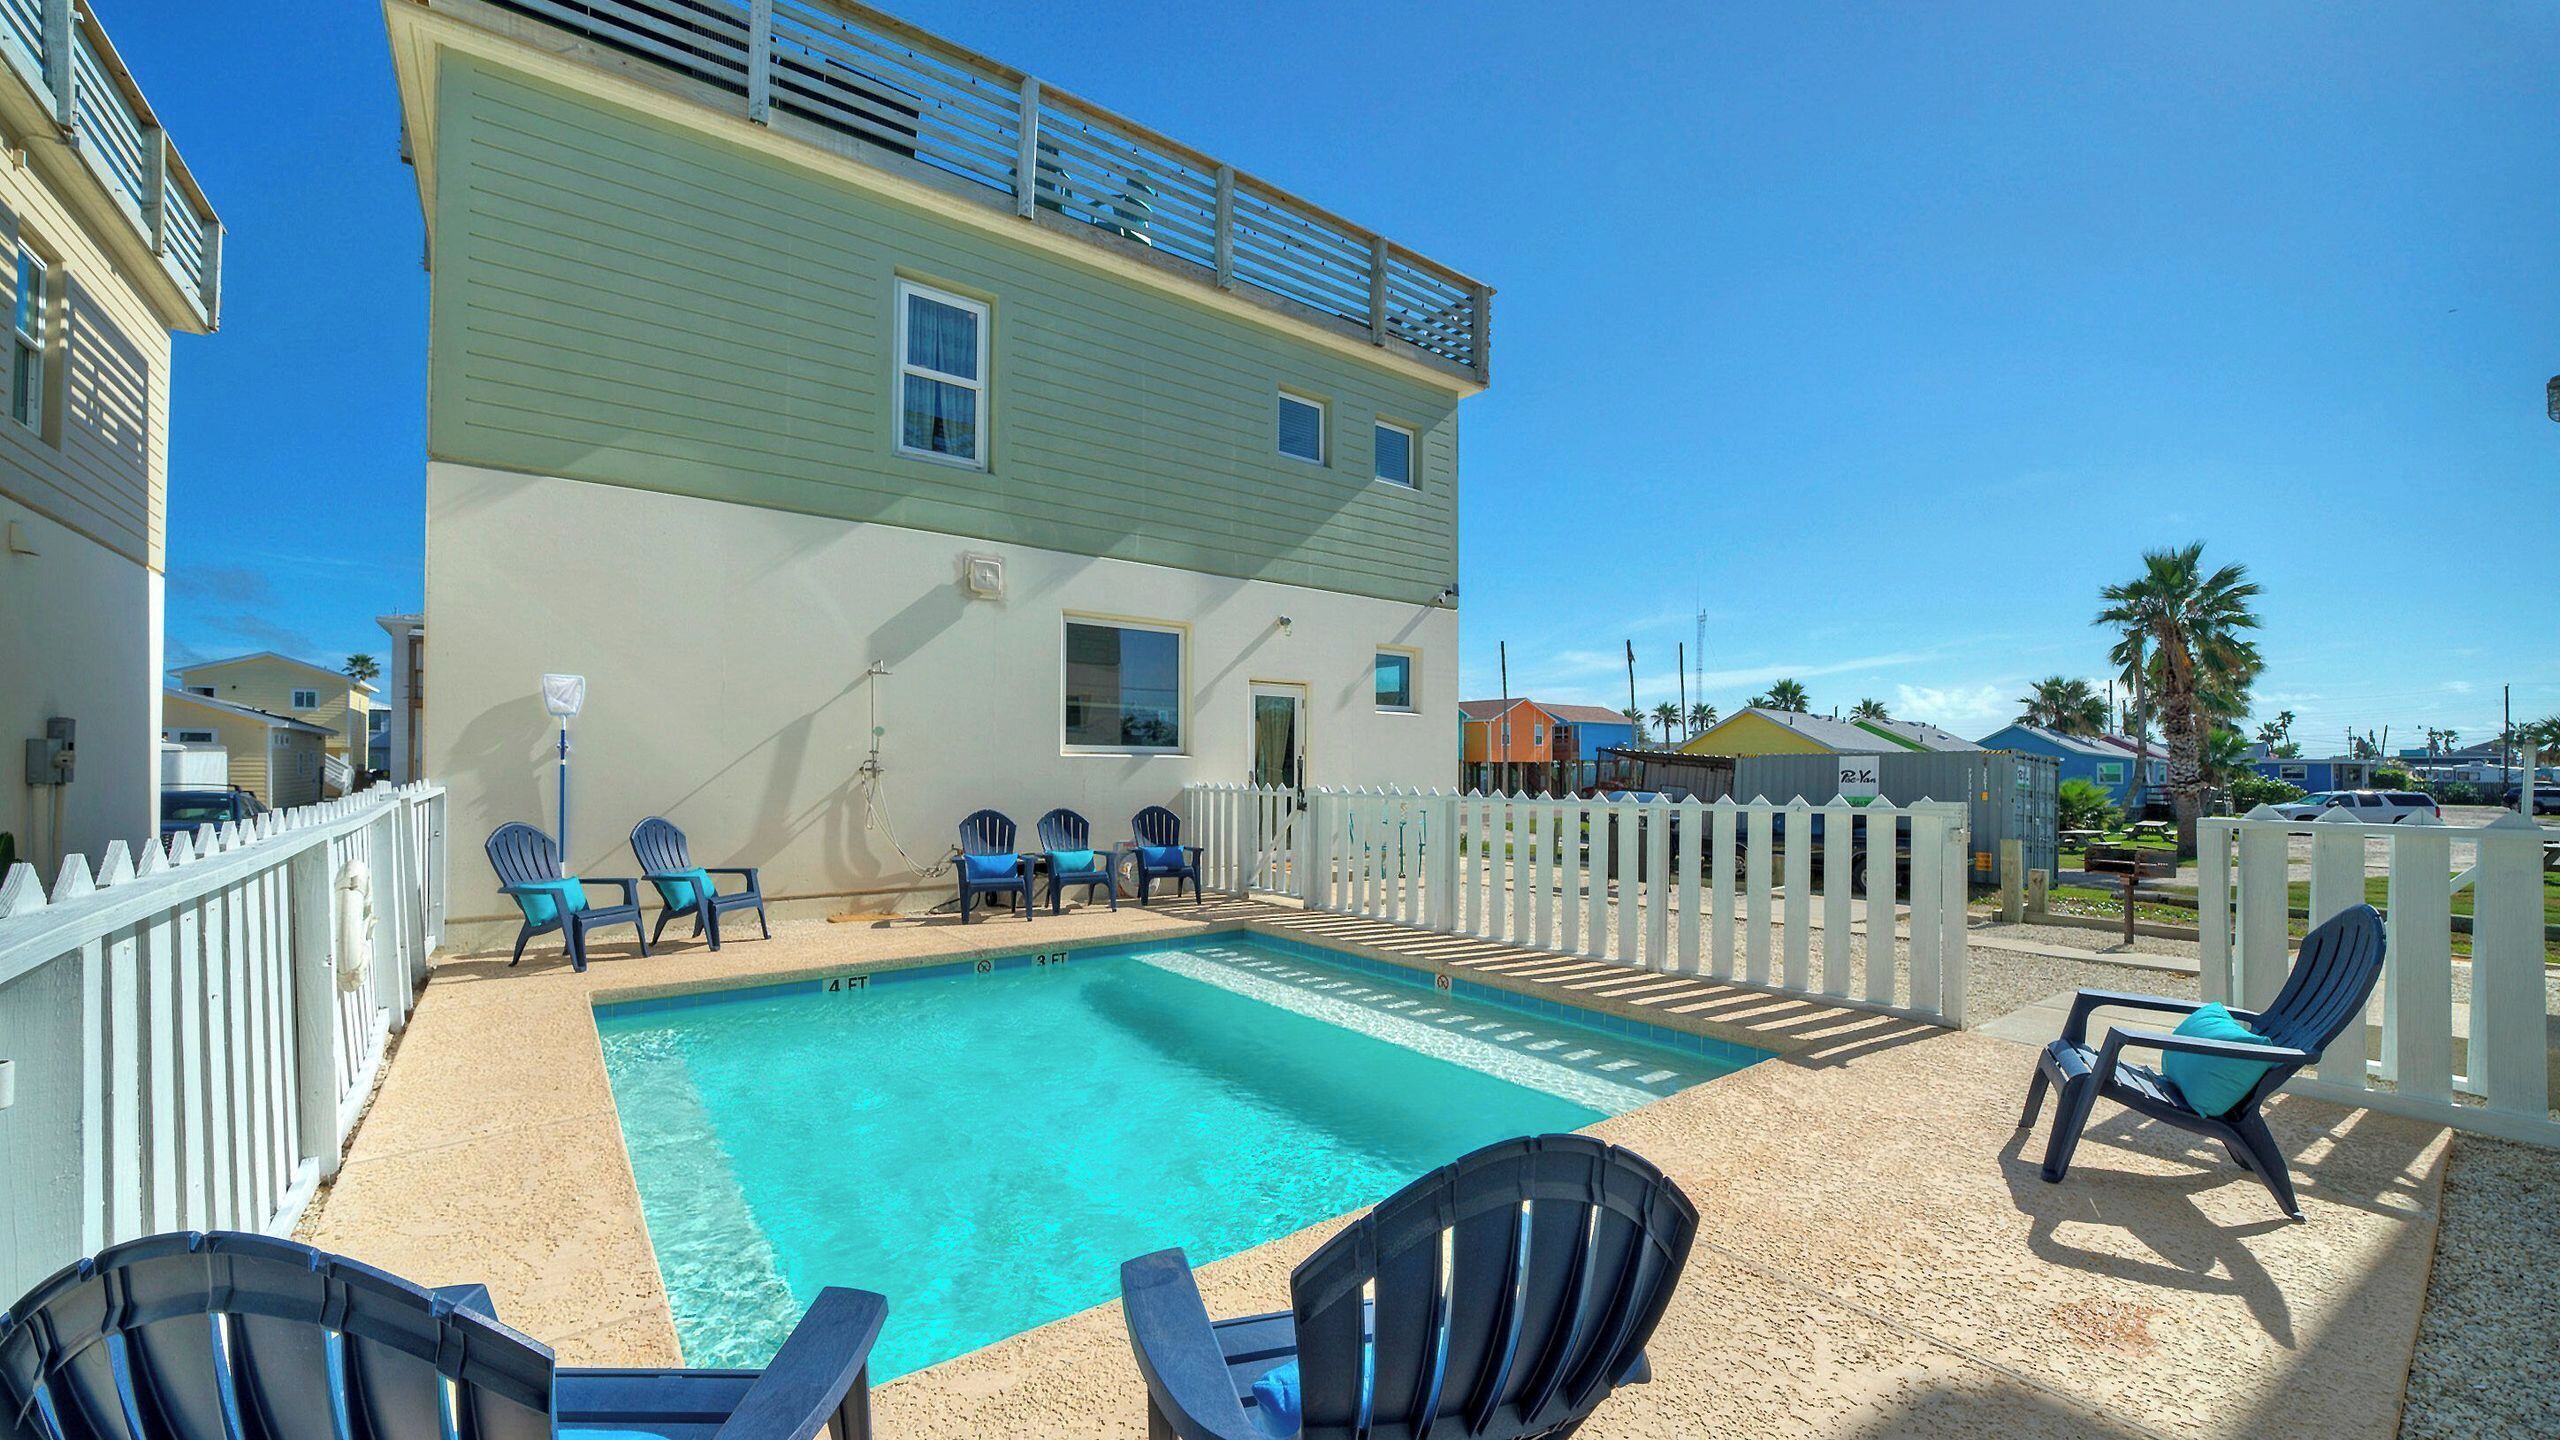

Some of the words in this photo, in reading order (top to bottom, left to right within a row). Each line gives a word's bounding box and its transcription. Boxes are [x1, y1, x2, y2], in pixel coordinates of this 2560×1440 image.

[1037, 954, 1046, 967] 3
[1051, 952, 1067, 965] FT
[828, 979, 841, 992] 4
[848, 975, 868, 991] FT
